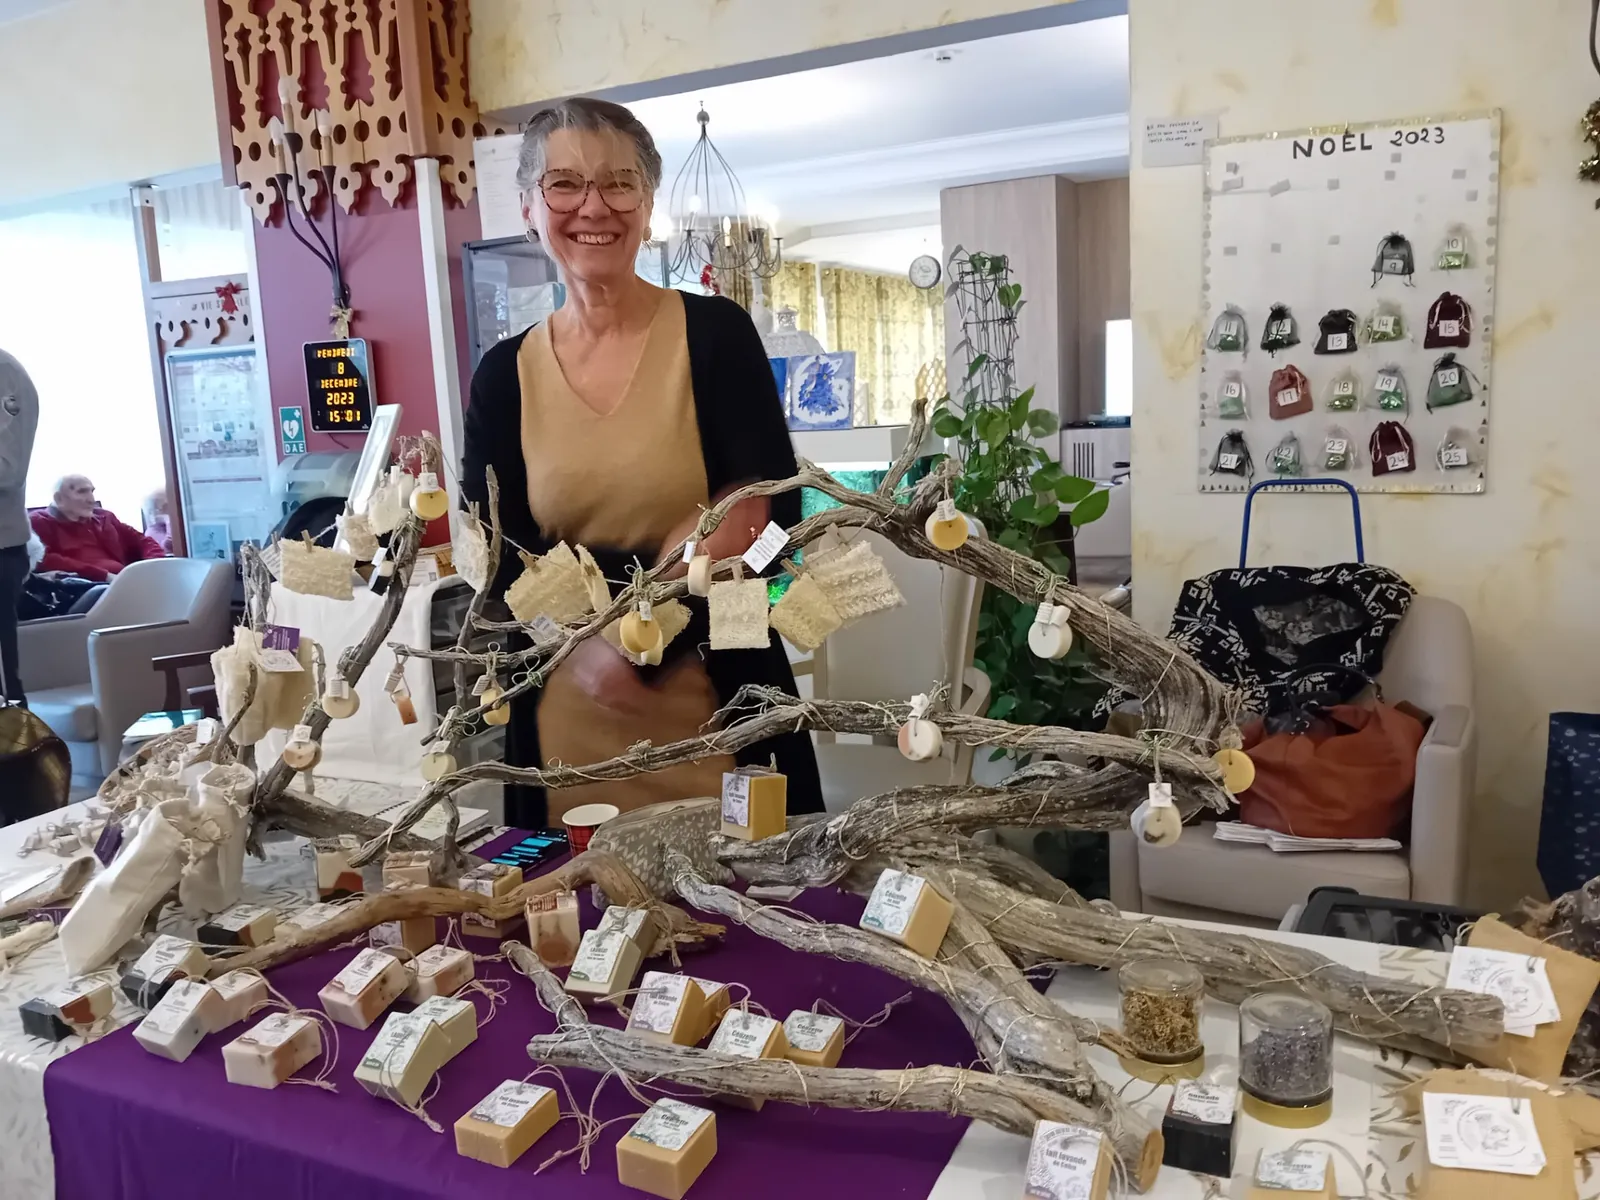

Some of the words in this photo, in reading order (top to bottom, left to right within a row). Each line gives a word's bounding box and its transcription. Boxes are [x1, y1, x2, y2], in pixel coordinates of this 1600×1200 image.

[1390, 127, 1446, 147] 2023
[1446, 238, 1459, 249] 10
[1389, 261, 1397, 271] 9
[1224, 321, 1232, 332] 11
[1276, 321, 1288, 333] 12
[1378, 318, 1390, 330] 14
[1443, 323, 1455, 334] 15
[1331, 336, 1343, 347] 13
[317, 347, 355, 358] VENDREDI
[337, 362, 345, 375] 8
[1380, 377, 1393, 388] 19
[1440, 371, 1458, 383] 20
[321, 378, 358, 389] DECEMBRE
[1338, 381, 1350, 392] 18
[1225, 384, 1236, 395] 16
[326, 392, 355, 405] 2023
[1282, 391, 1294, 402] 17
[329, 410, 361, 422] 15:01
[285, 443, 305, 453] DAE
[1328, 439, 1344, 450] 23
[1277, 447, 1291, 458] 22
[1444, 452, 1461, 464] 25
[1222, 455, 1234, 466] 21
[1390, 455, 1406, 467] 24
[1059, 1152, 1087, 1166] lavande
